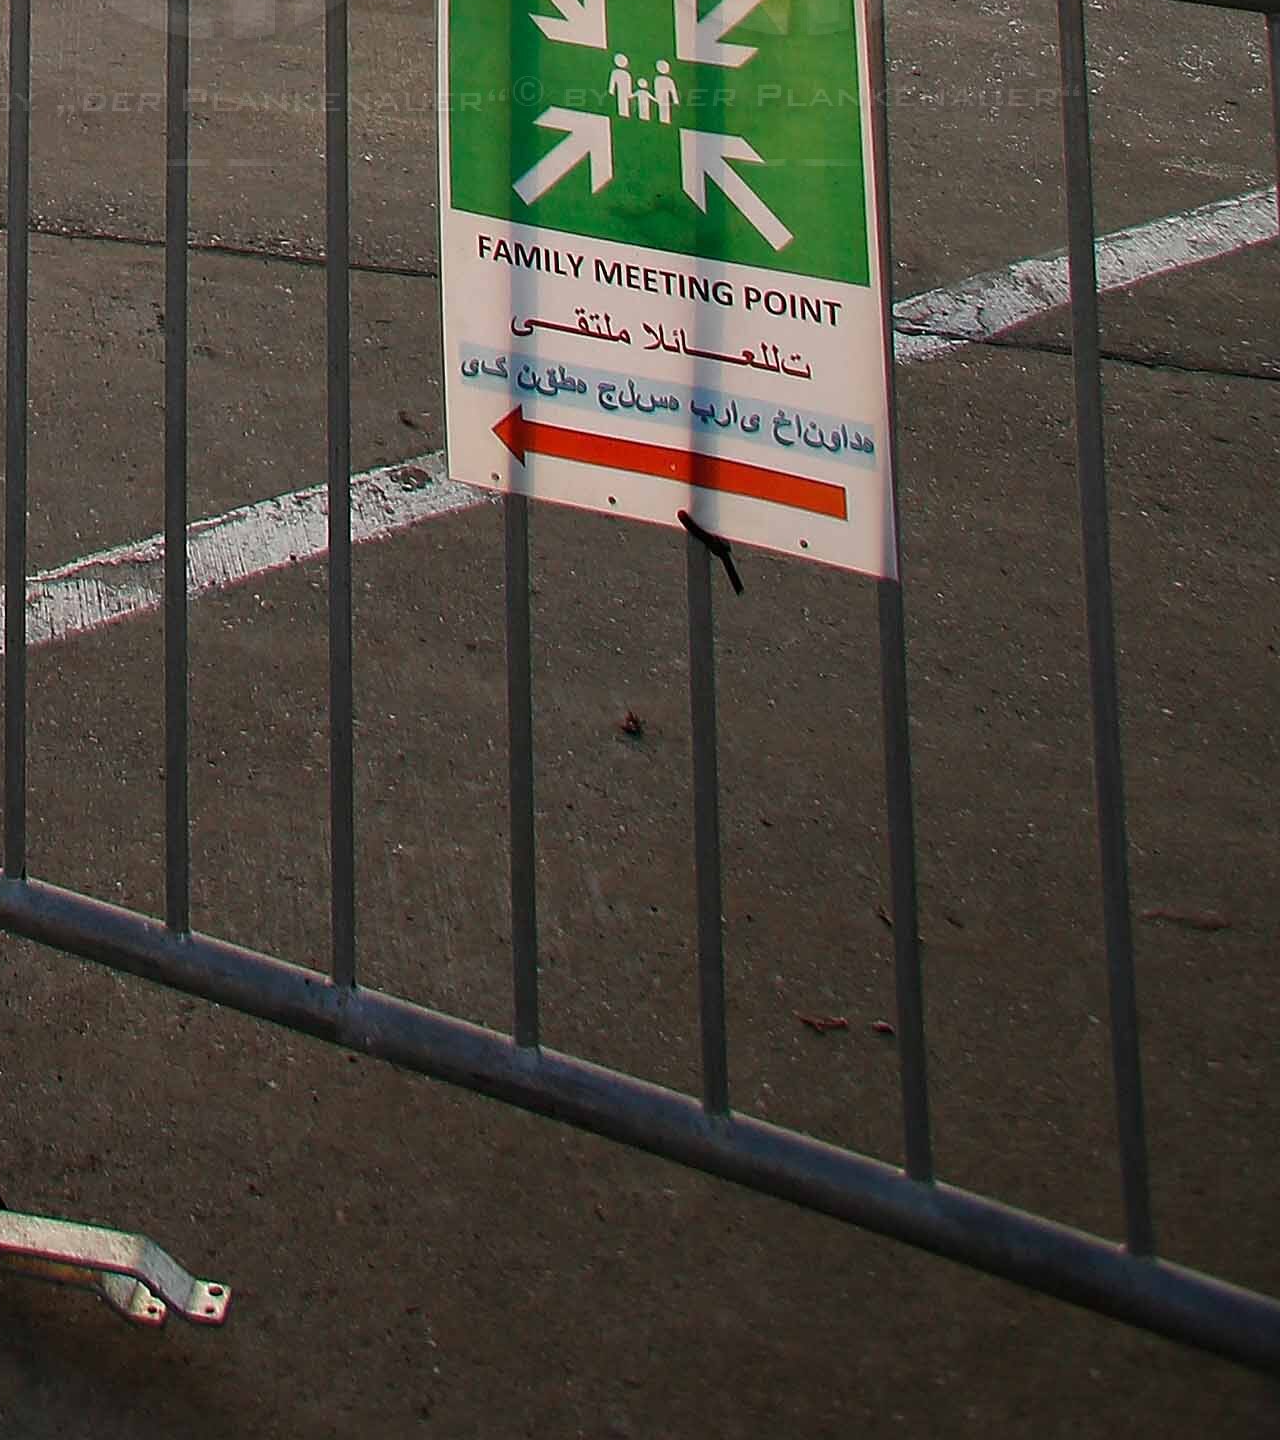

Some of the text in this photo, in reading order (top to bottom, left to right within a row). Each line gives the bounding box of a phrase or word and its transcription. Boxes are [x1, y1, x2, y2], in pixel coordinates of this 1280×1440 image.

[478, 234, 842, 327] FAMILY MEETING POINT
